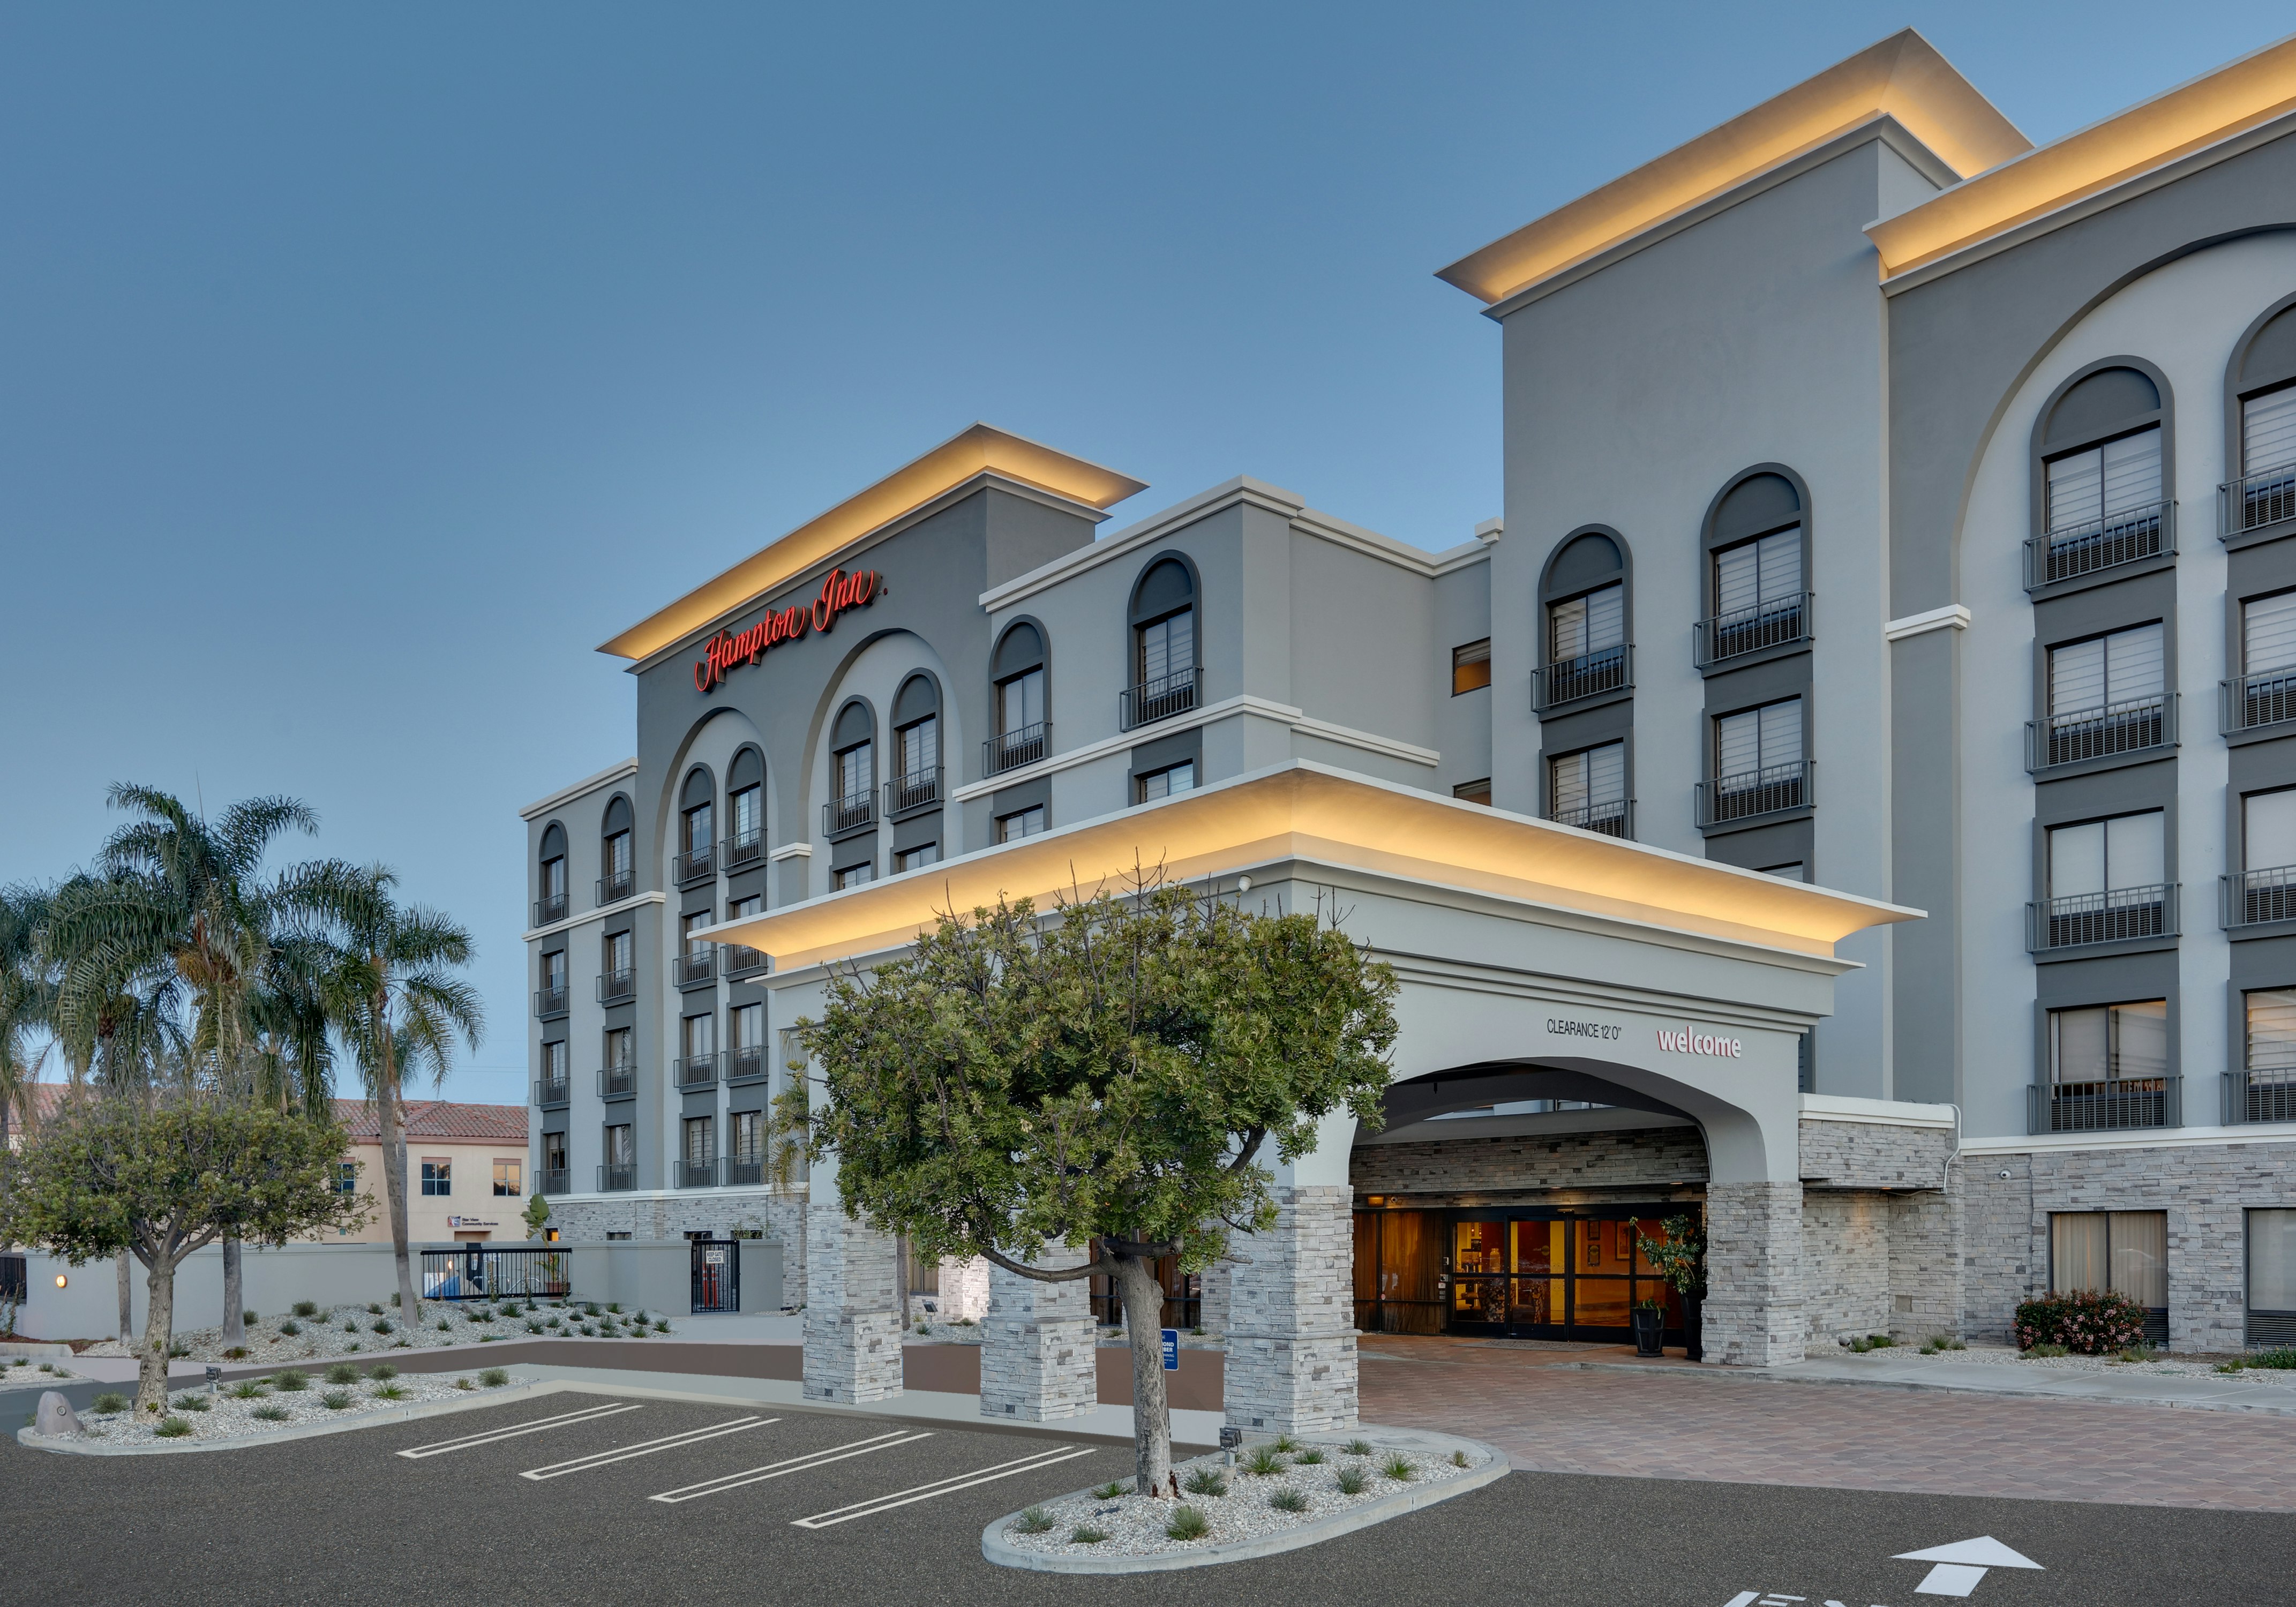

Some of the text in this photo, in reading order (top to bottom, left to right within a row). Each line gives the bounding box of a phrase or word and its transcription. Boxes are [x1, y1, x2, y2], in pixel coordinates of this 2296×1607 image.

[694, 568, 880, 692] Hampton Inn
[1547, 1019, 1599, 1038] CLEARANCE
[1657, 1026, 1742, 1058] welcome
